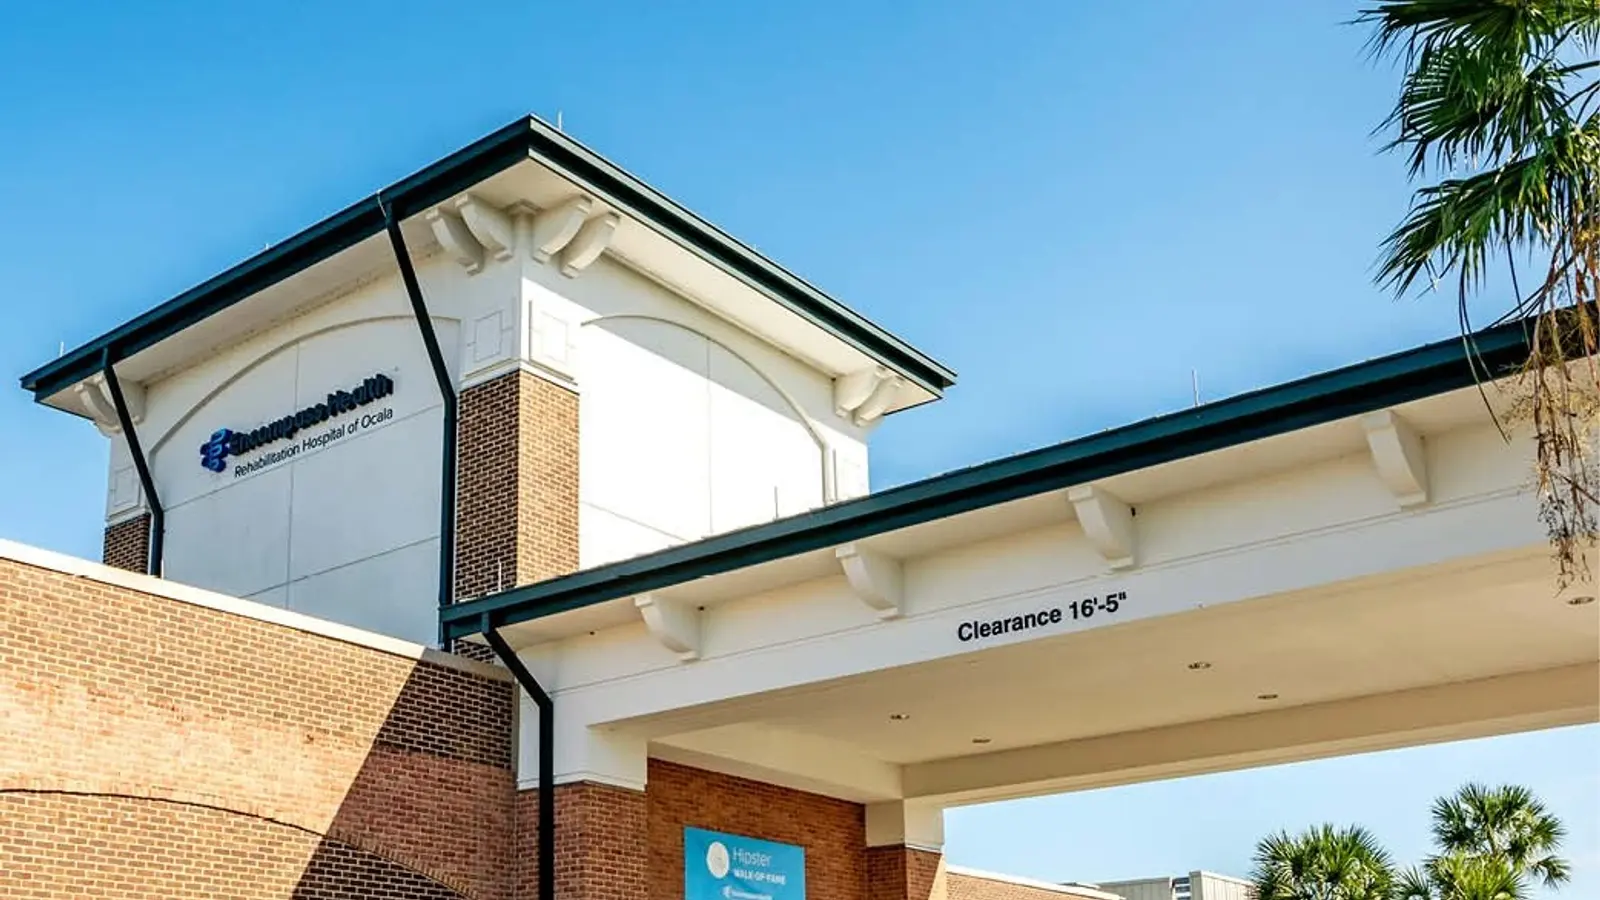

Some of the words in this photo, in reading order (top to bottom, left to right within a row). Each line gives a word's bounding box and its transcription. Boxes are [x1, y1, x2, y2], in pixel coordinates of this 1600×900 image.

[229, 403, 328, 455] Encompass
[328, 373, 394, 416] Health
[234, 443, 300, 478] Rehabilitation
[302, 428, 345, 453] Hospital
[347, 421, 358, 434] of
[362, 407, 393, 428] Ocala
[957, 608, 1062, 642] Clearance
[1069, 591, 1127, 619] 16'-5"
[732, 846, 772, 868] Hipster
